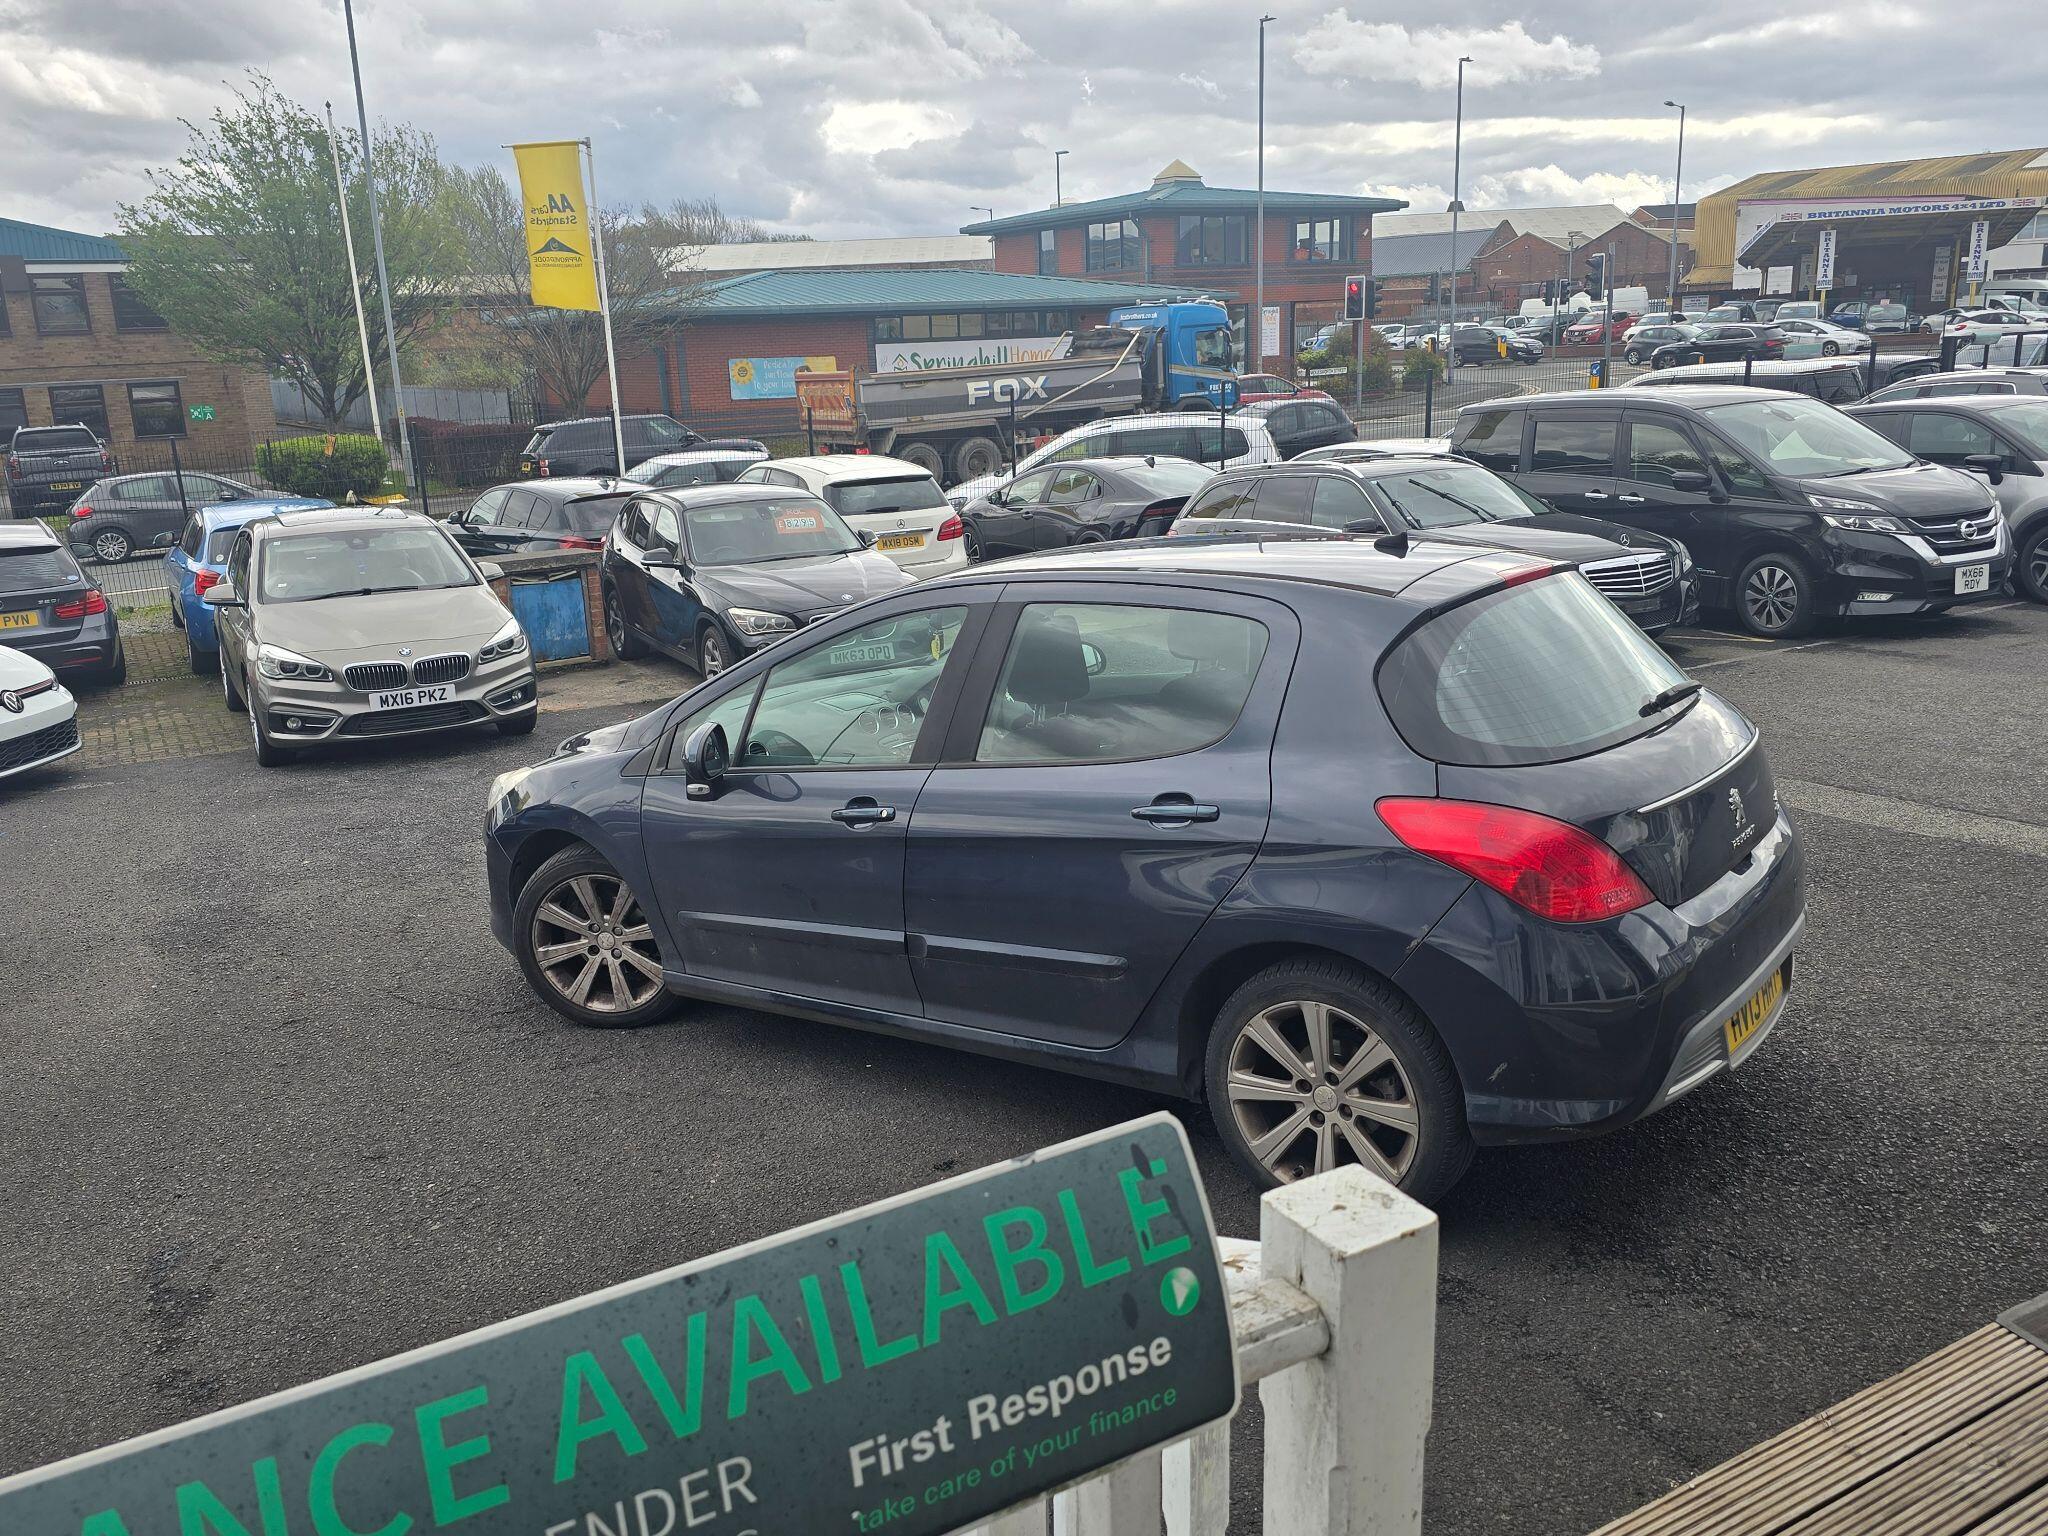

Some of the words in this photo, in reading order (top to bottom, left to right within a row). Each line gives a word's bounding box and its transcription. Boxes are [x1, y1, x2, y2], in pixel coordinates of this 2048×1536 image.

[1807, 207, 1886, 219] BRITANNIA
[1888, 203, 1950, 215] MOTORS
[1951, 202, 1977, 211] 4x4
[1978, 200, 2007, 209] LTD
[1821, 231, 1833, 279] BRITANNIA
[1971, 222, 1985, 271] BRITANNIA
[966, 375, 1049, 406] FOX
[1961, 567, 1984, 579] MX66
[1963, 579, 1980, 590] RDY
[3, 614, 30, 627] PVN
[834, 648, 866, 664] MK63
[379, 692, 414, 708] MX16
[417, 687, 448, 704] PKZ
[1731, 823, 1756, 848] PEUGEOT
[79, 1384, 511, 1536] NCE
[553, 1158, 1193, 1485] AVAILABLE
[849, 1415, 956, 1488] First
[967, 1336, 1172, 1440] Response
[857, 1499, 915, 1533] take
[923, 1467, 982, 1506] care
[989, 1446, 1017, 1478] of
[1022, 1424, 1083, 1469] your
[1088, 1386, 1178, 1438] finance
[544, 1456, 759, 1536] NDER
